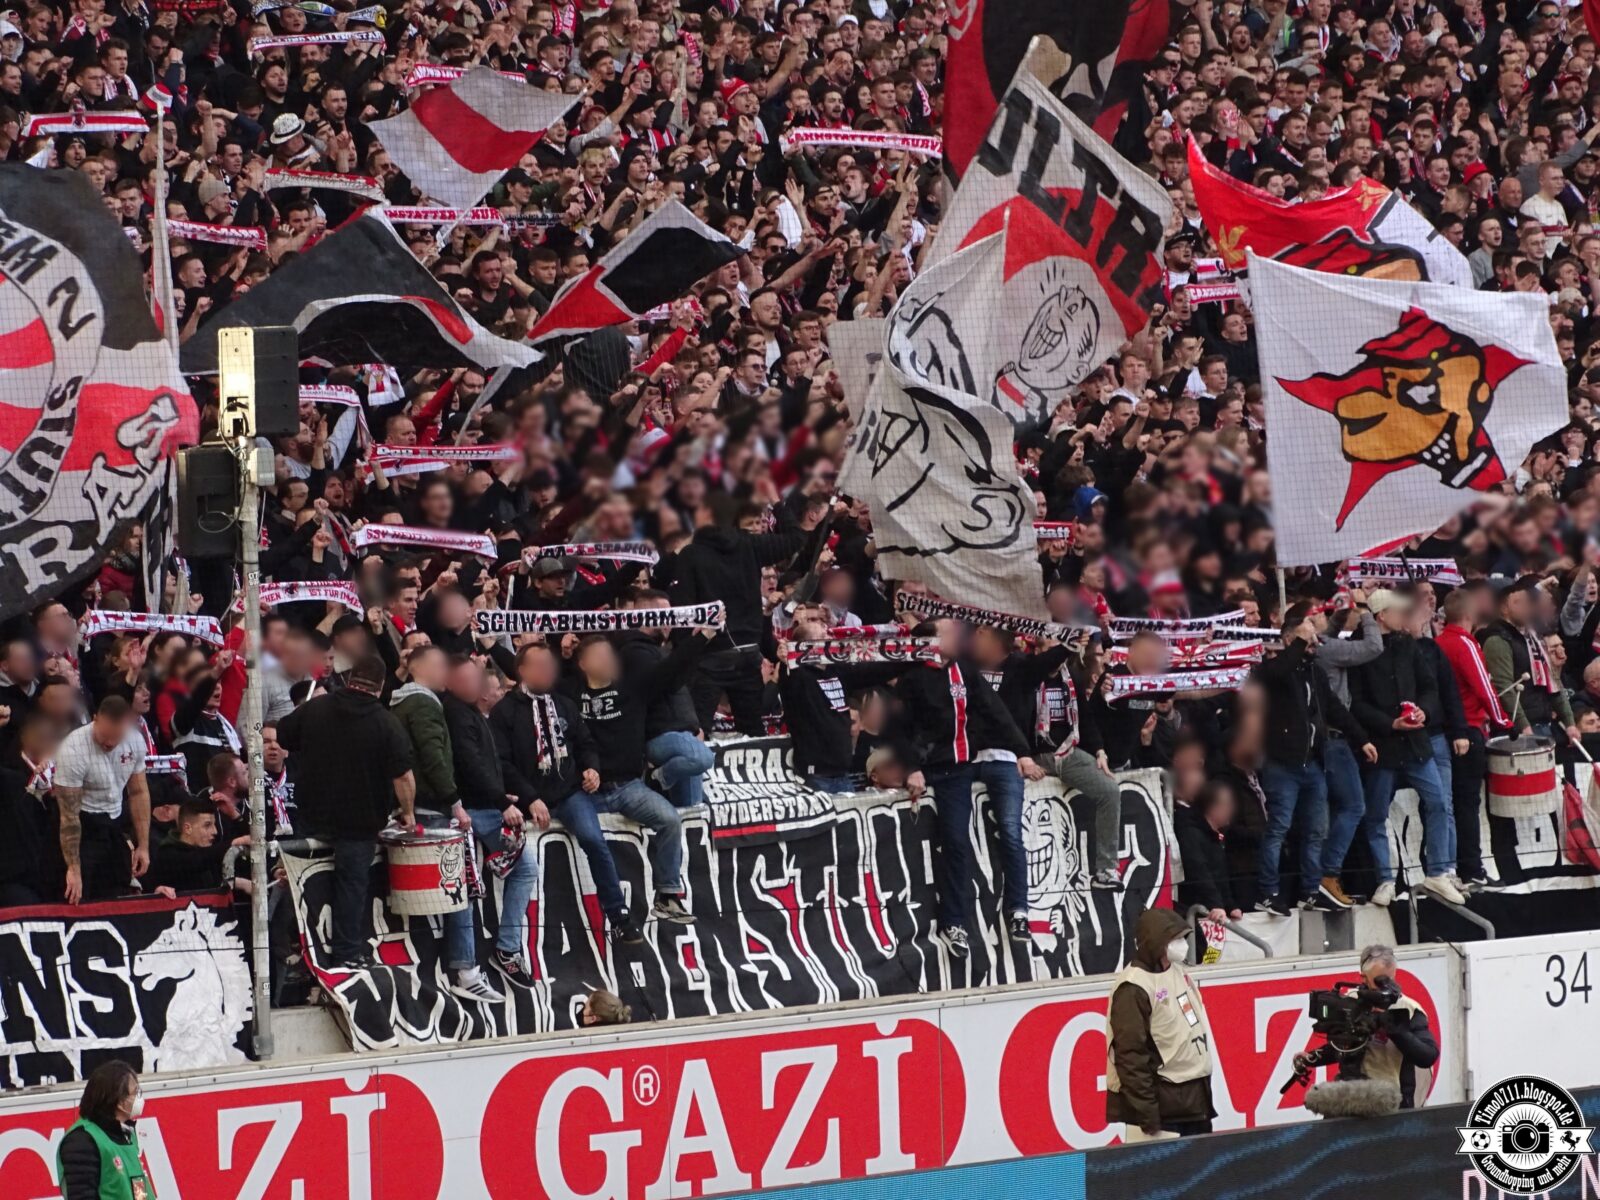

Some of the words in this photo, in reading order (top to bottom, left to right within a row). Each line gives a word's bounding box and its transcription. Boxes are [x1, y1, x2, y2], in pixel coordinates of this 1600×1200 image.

[477, 608, 676, 635] SCHWABENSTURM
[694, 604, 720, 626] 02
[711, 790, 834, 827] WIDERSTAND
[1545, 951, 1593, 1008] 34
